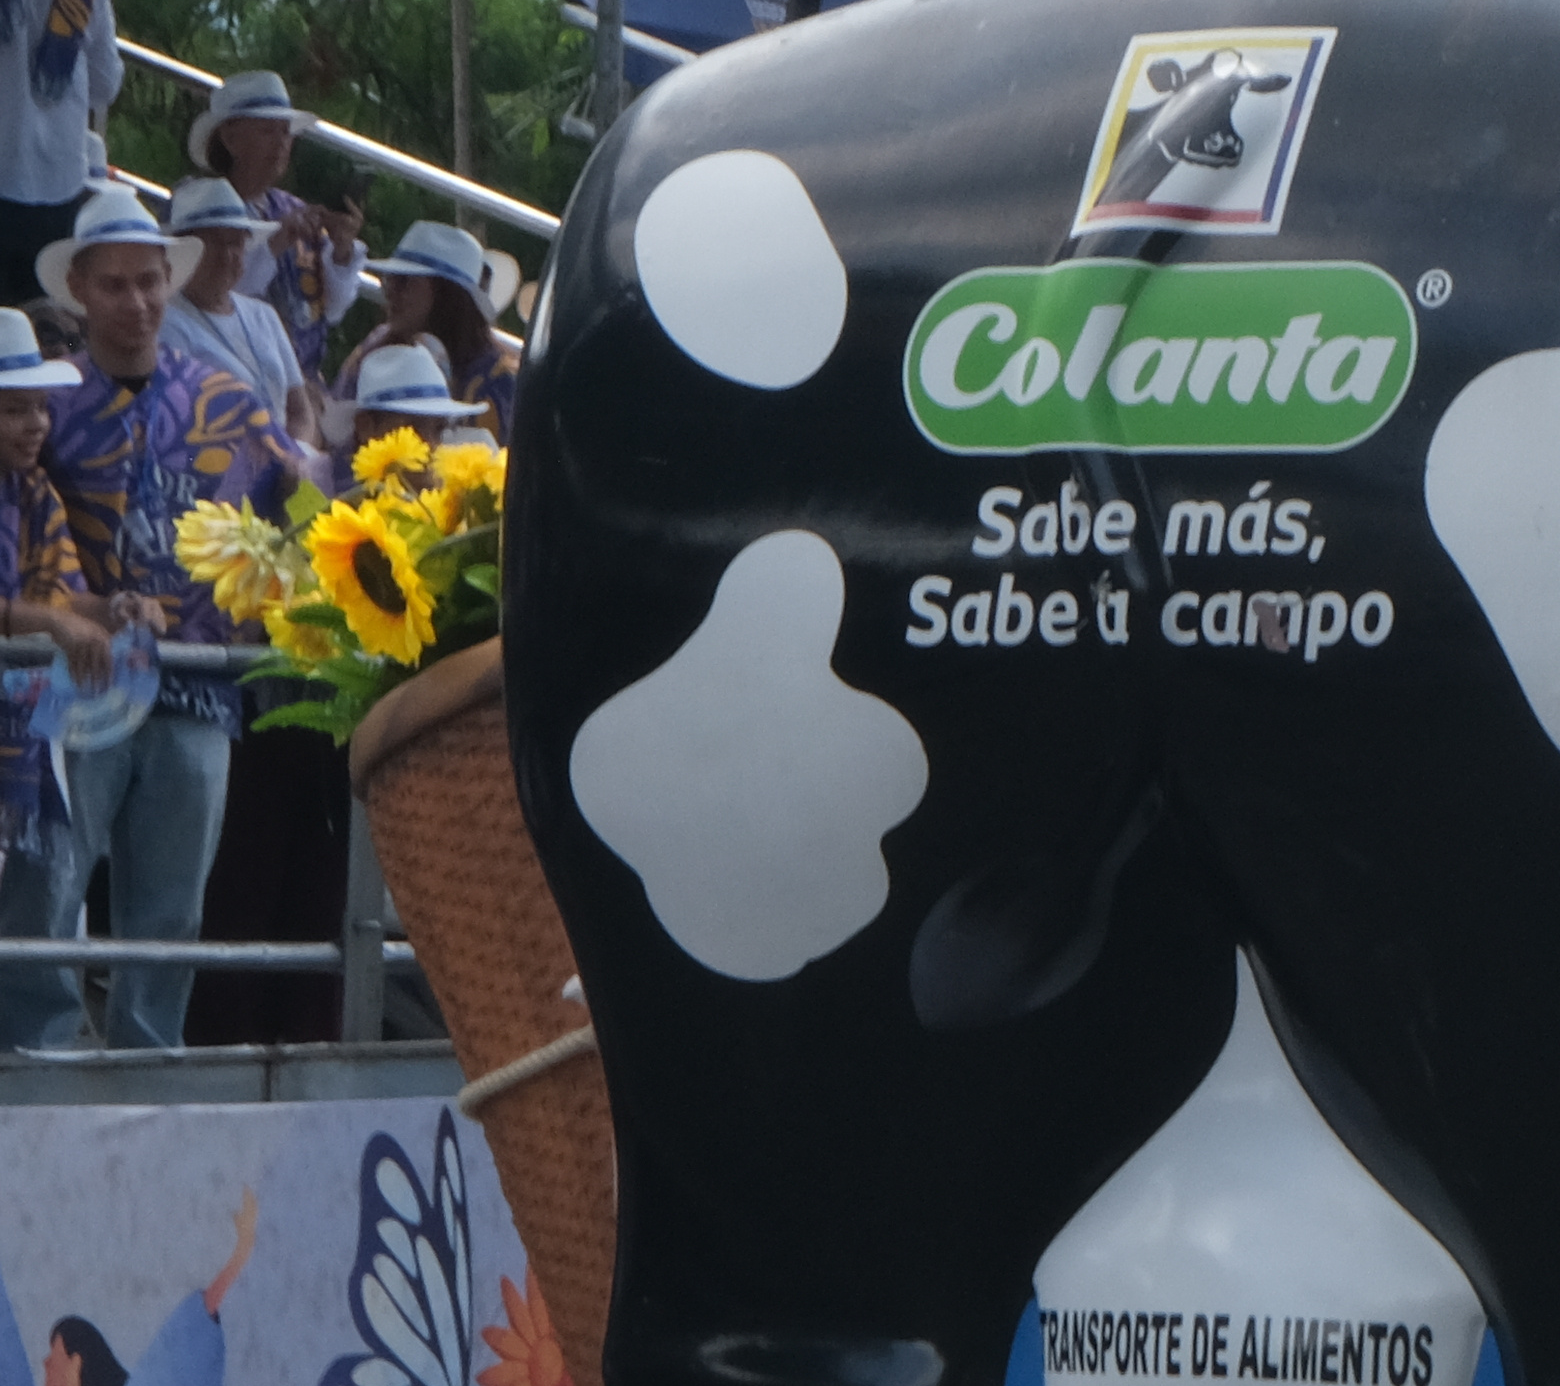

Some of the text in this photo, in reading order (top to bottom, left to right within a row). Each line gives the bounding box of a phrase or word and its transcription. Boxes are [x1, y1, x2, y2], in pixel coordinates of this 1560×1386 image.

[918, 301, 1398, 411] Colanta
[971, 480, 1327, 563] Sabe más,
[904, 573, 1078, 649] Sabe
[1161, 588, 1395, 663] campo
[1040, 1308, 1183, 1378] TRANSPORTE
[1192, 1313, 1229, 1378] DE
